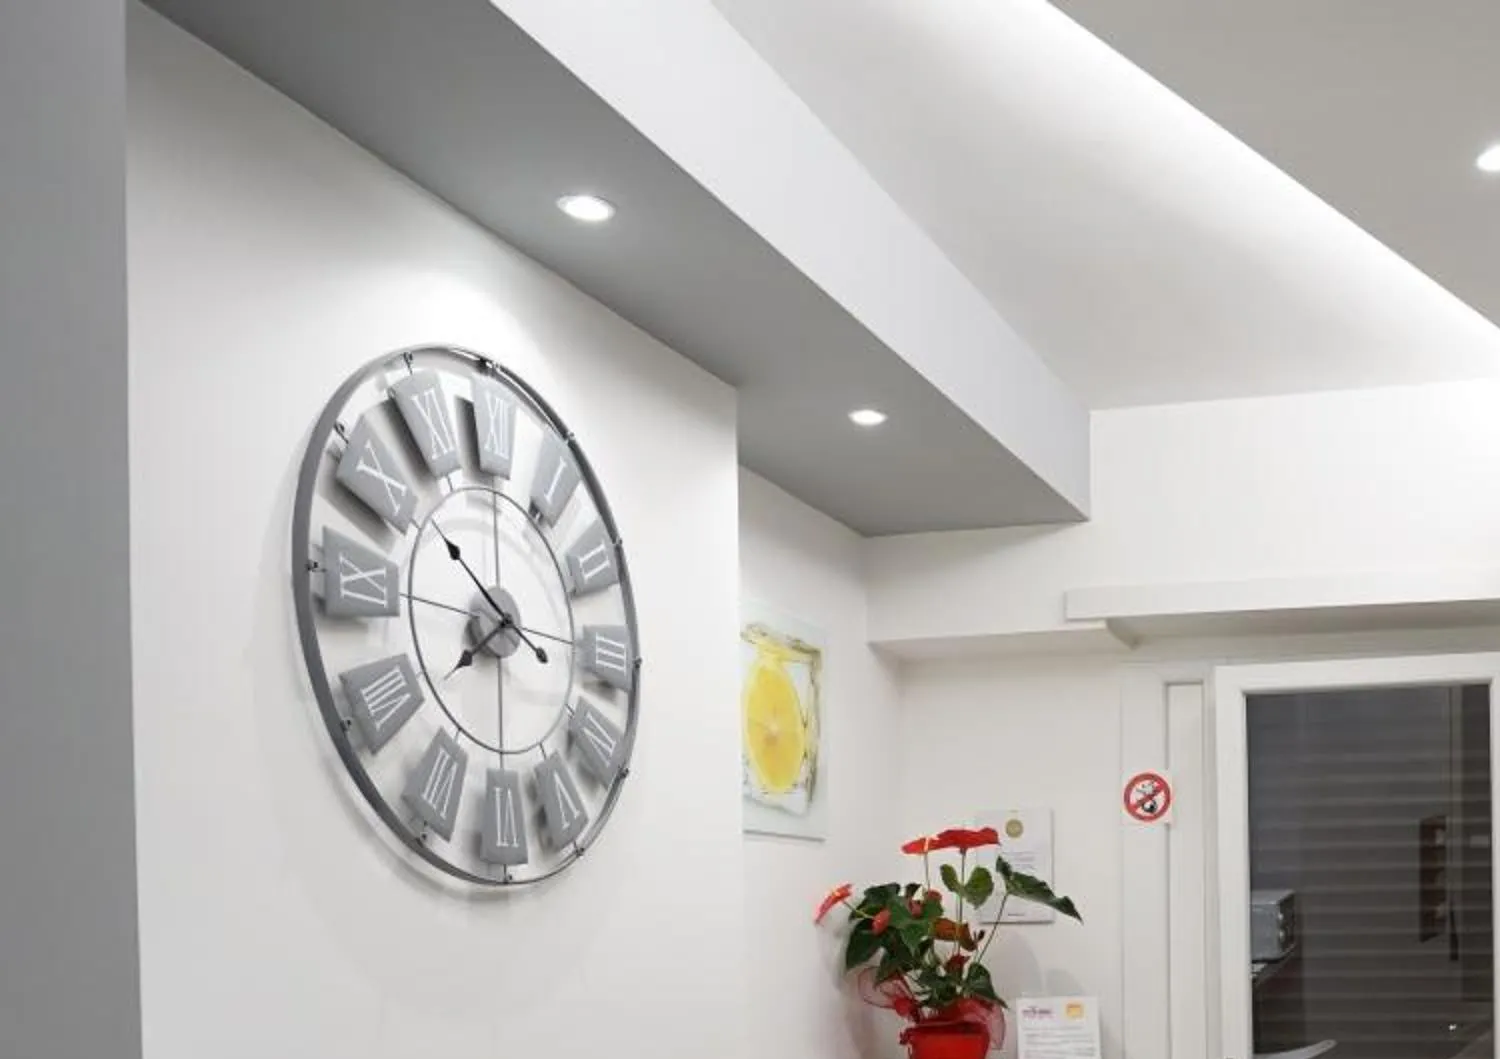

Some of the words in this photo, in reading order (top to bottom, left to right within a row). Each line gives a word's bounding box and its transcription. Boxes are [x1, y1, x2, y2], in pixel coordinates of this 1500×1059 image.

[412, 387, 456, 461] XI
[484, 390, 511, 460] XII
[356, 438, 407, 516] X
[544, 456, 567, 505] I
[339, 553, 388, 608] IX
[577, 541, 611, 580] II
[595, 632, 628, 677] III
[360, 665, 412, 731] VIII
[582, 711, 617, 769] IV
[422, 747, 459, 820] VII
[553, 771, 581, 828] V
[495, 787, 519, 848] VI
